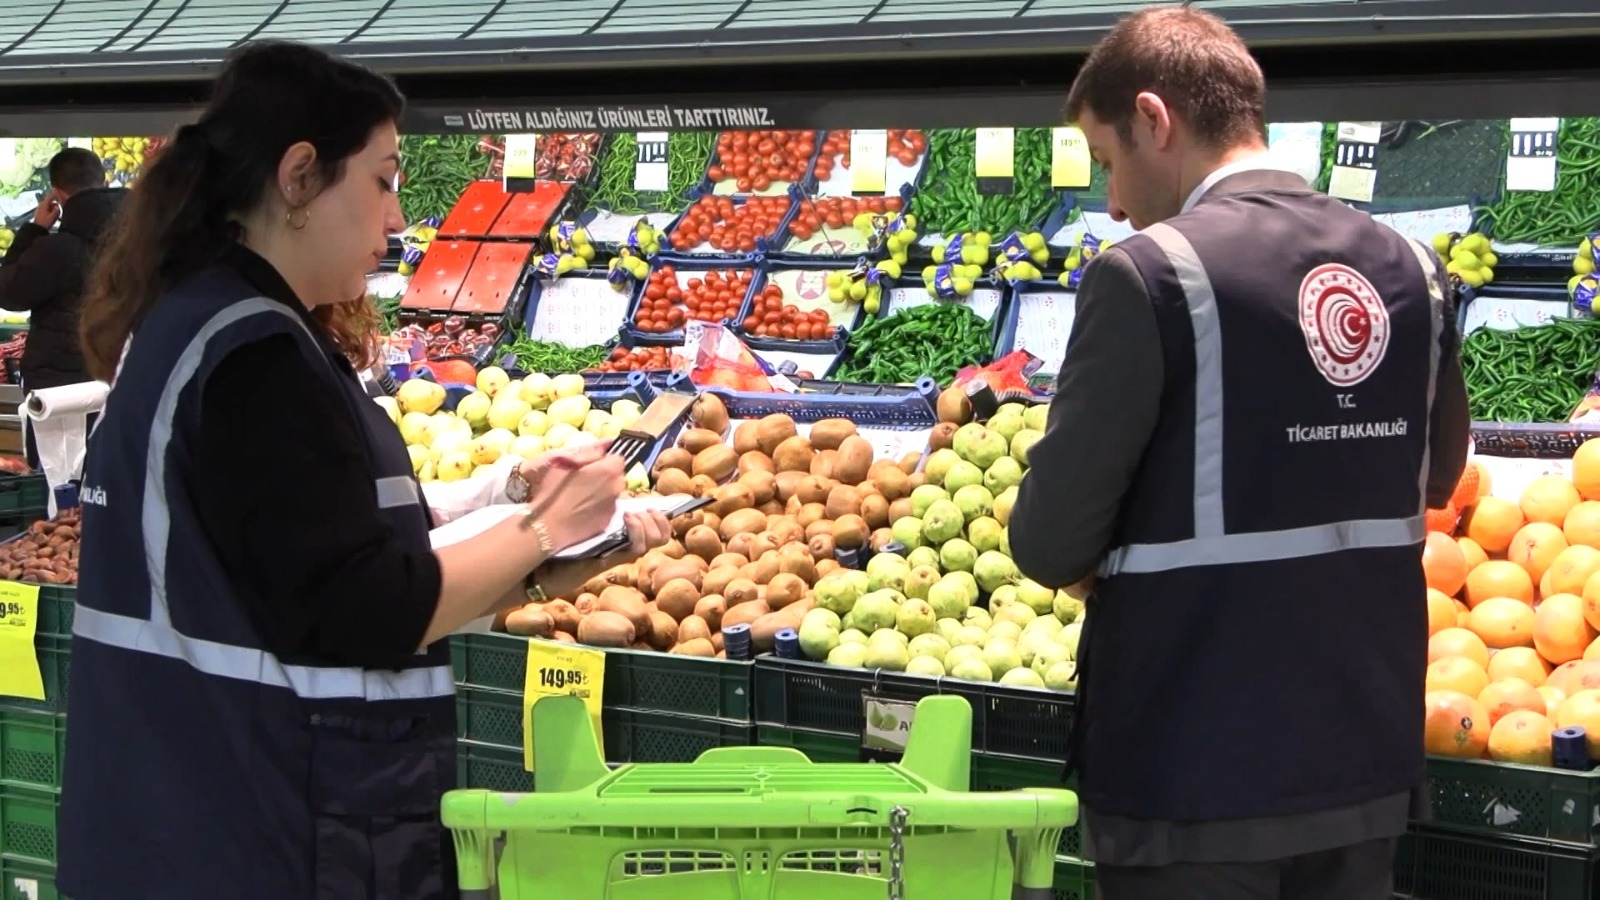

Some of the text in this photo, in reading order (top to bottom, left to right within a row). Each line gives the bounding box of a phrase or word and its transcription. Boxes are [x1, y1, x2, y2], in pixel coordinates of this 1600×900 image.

[467, 105, 776, 130] LÜTFEN ALDIĞINIZ ÜRÜNLERİ TARTTIRINIZ.
[1285, 417, 1408, 443] TİCARET BAKANLIĞI
